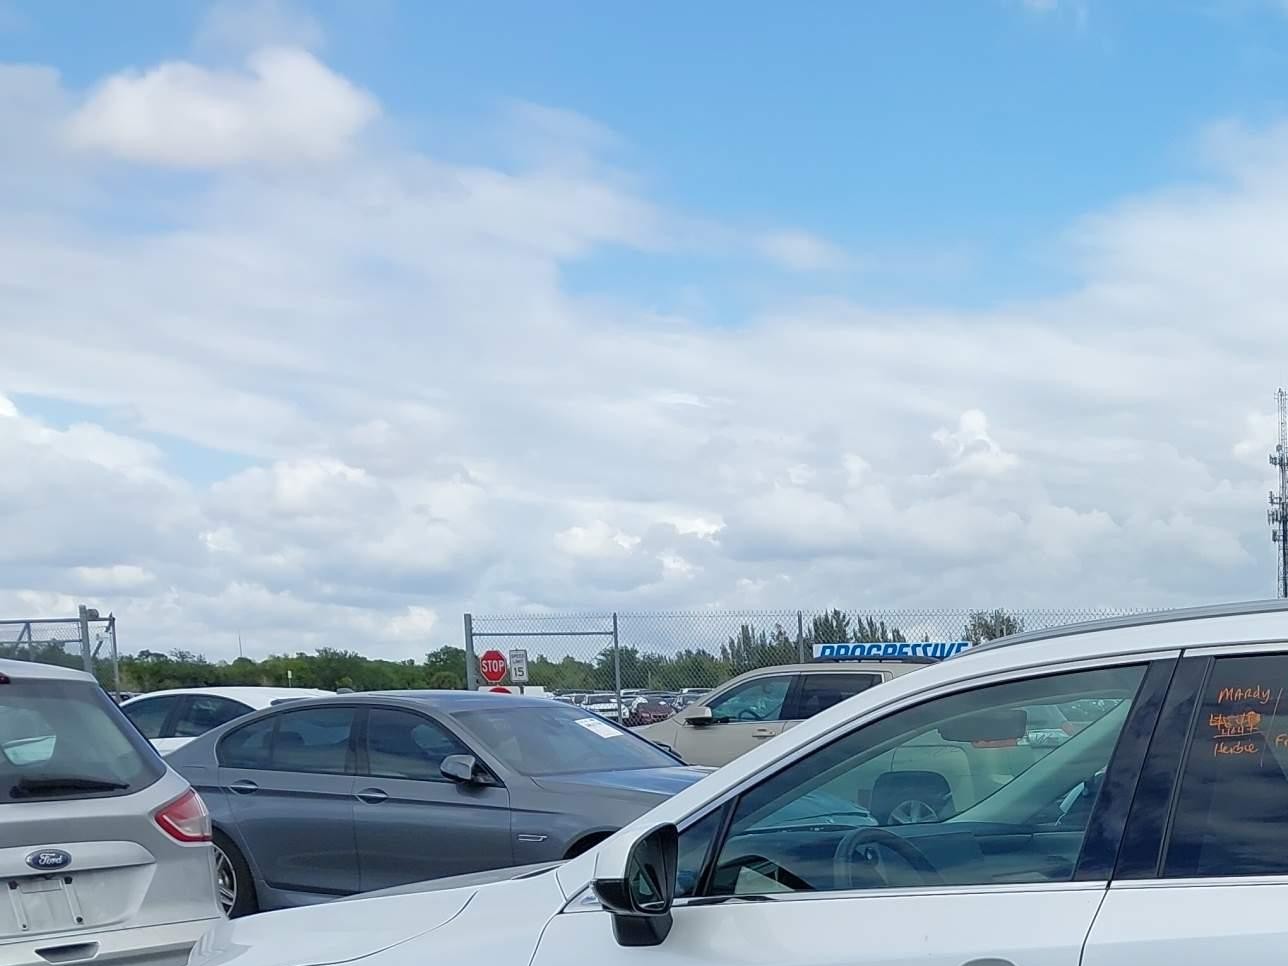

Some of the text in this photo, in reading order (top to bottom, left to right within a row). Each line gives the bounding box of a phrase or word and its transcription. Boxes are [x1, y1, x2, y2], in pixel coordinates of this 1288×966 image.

[481, 660, 505, 673] STOP
[513, 666, 525, 677] 15
[39, 853, 63, 865] Ford
